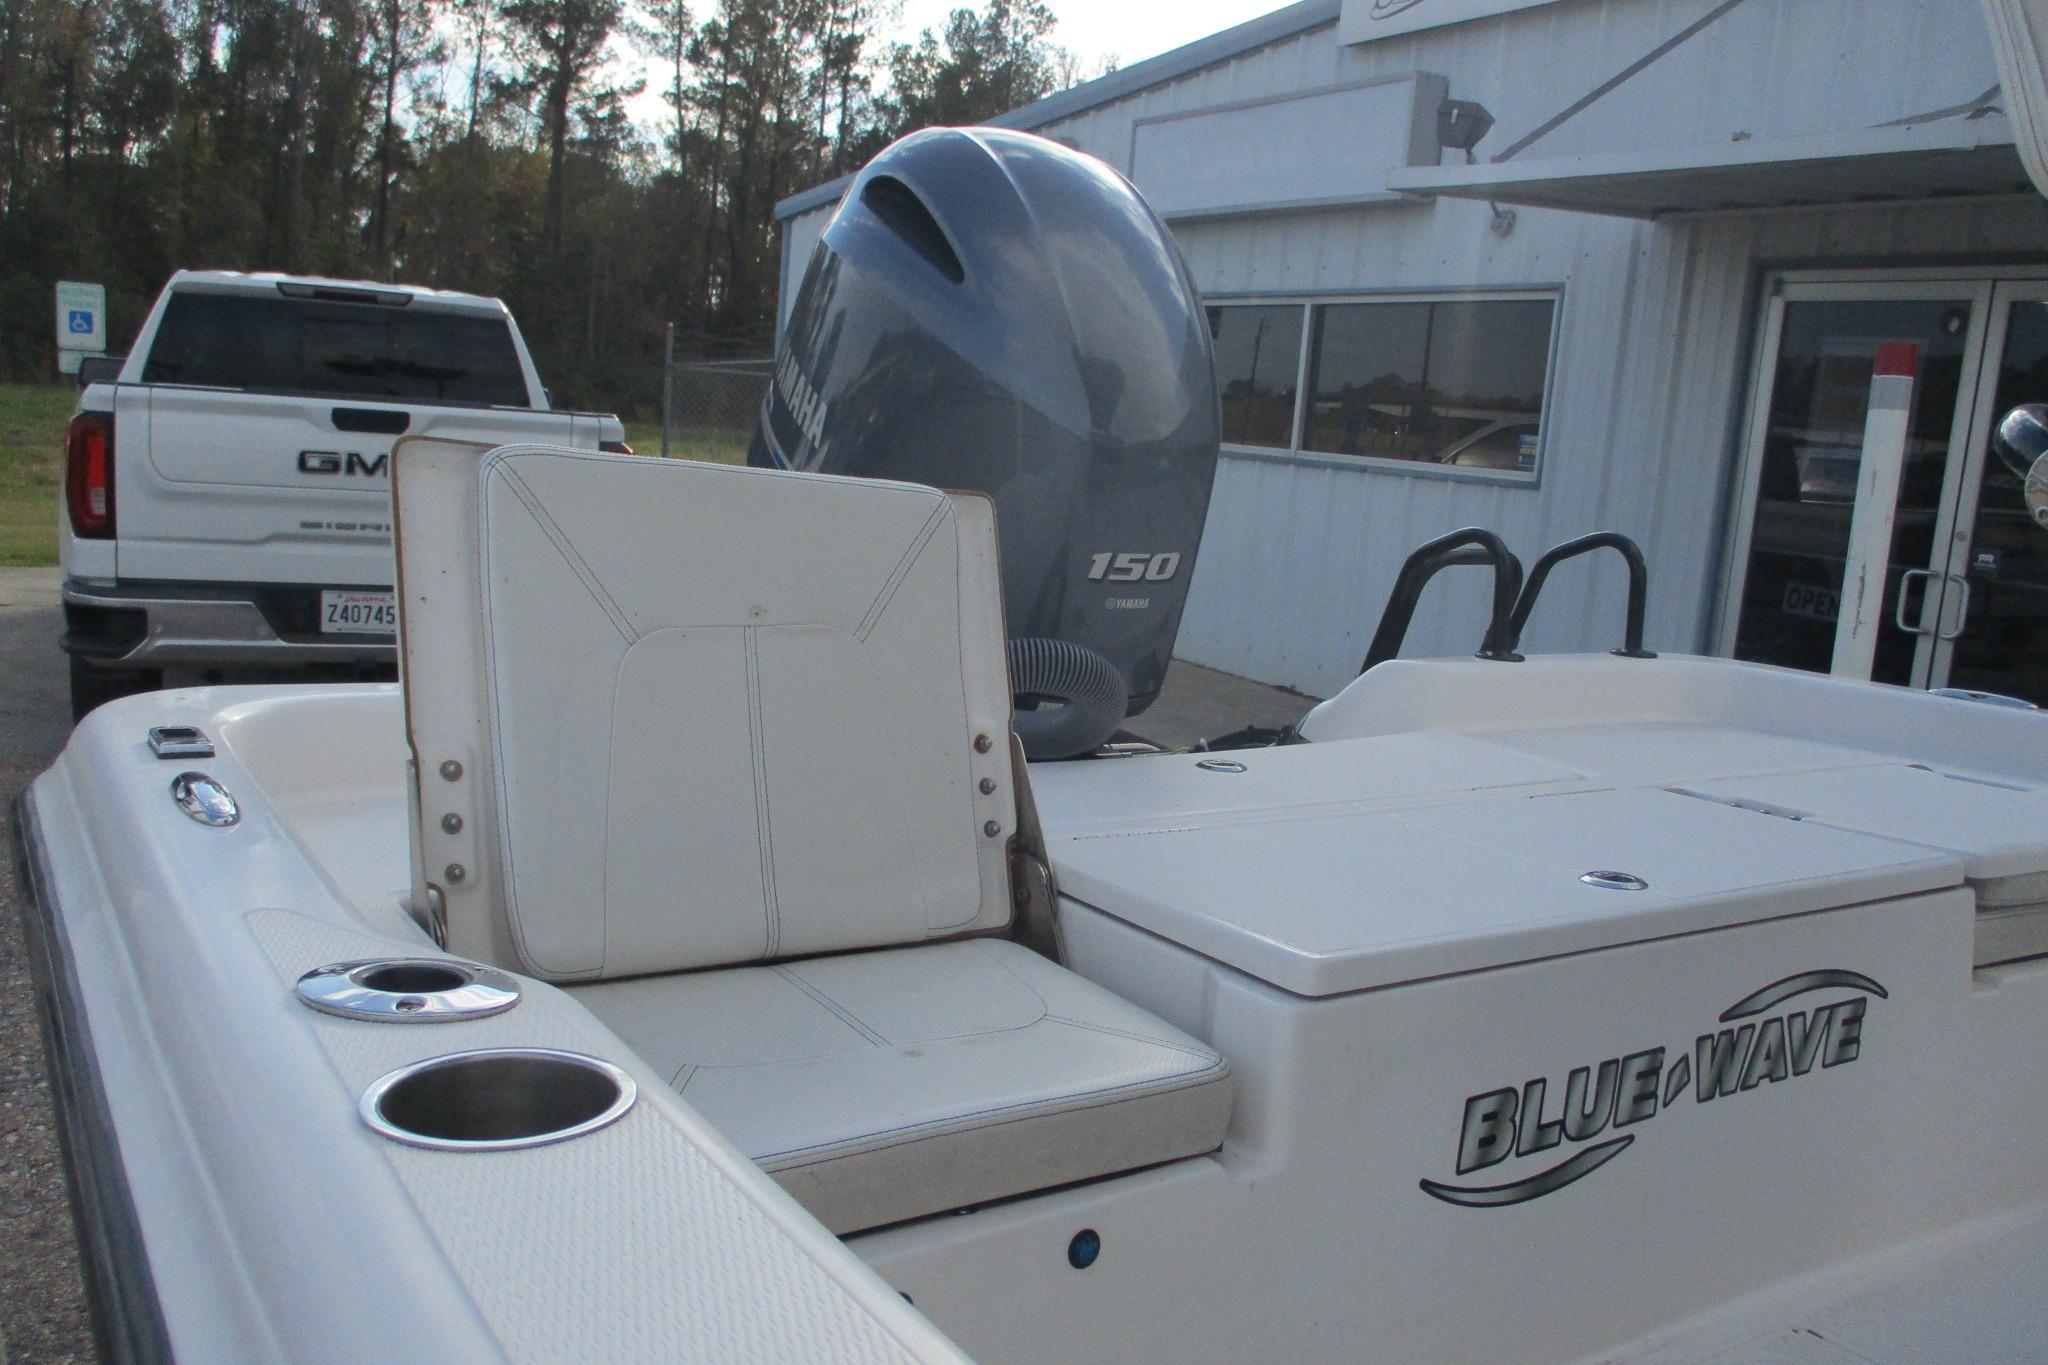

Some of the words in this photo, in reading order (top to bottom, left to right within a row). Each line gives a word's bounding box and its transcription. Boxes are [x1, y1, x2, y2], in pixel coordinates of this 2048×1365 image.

[300, 522, 391, 532] SIER
[1088, 552, 1180, 581] 150
[1116, 598, 1149, 609] YAMAHA
[328, 604, 395, 625] Z40745
[1455, 1046, 1666, 1176] BLUE
[1695, 996, 1868, 1104] WAVE
